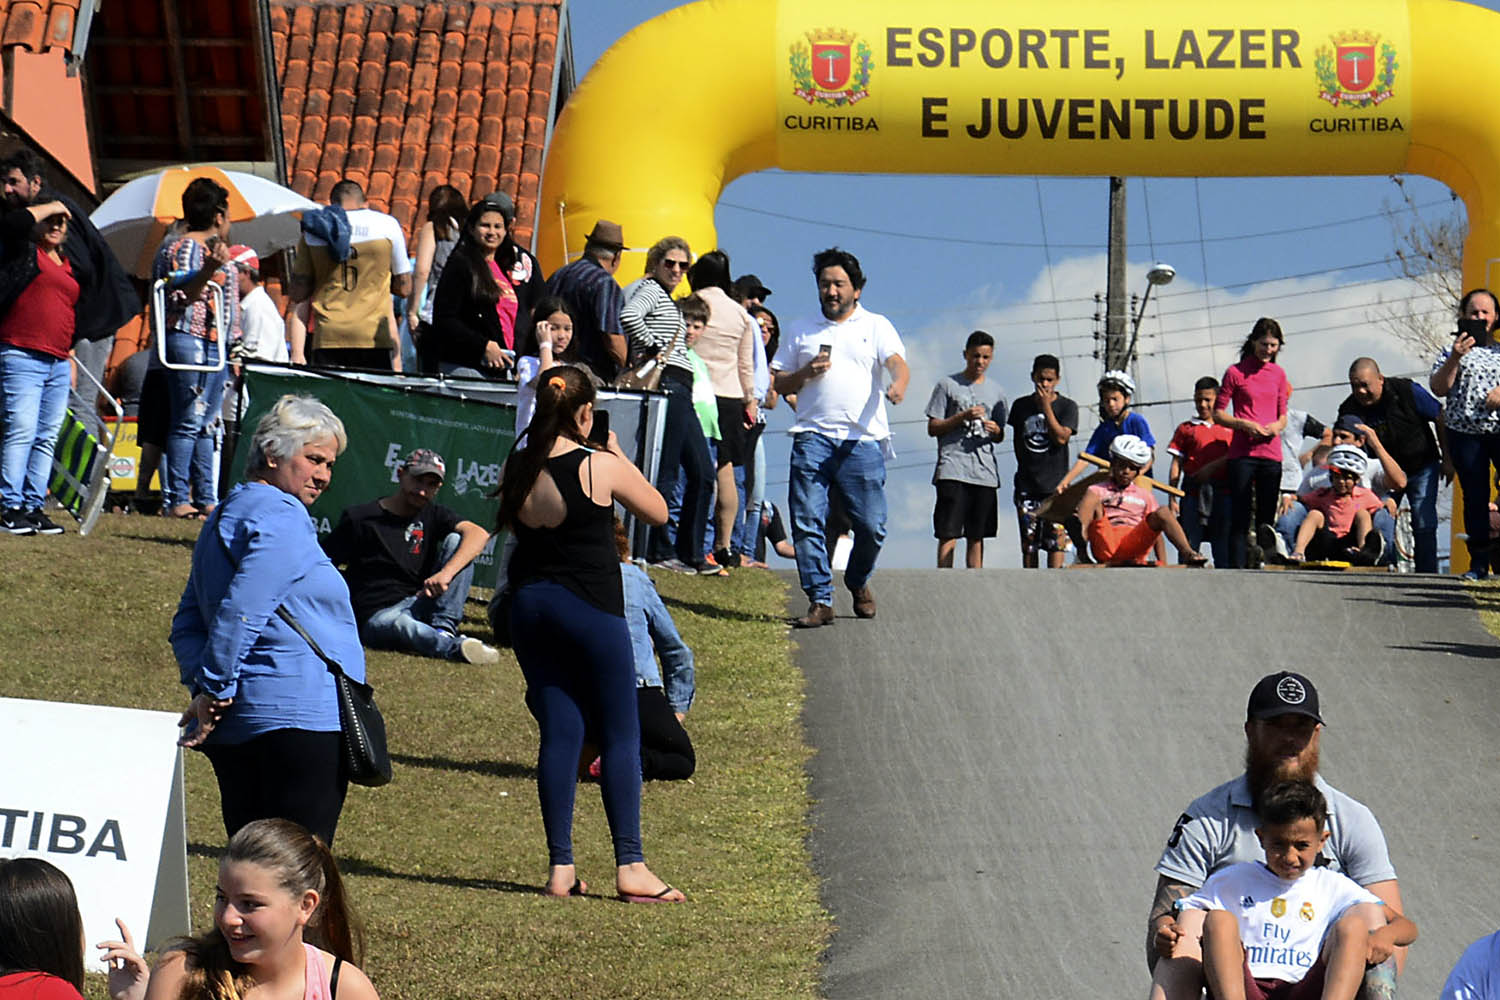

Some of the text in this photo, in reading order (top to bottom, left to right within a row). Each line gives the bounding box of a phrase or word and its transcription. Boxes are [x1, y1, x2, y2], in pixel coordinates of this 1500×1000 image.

[886, 27, 1302, 80] ESPORTE, LAZER
[784, 114, 880, 132] CURITIBA
[921, 97, 1267, 140] E JUVENTUDE
[1309, 116, 1404, 133] CURITIBA
[457, 458, 501, 487] LAZE
[1263, 922, 1291, 944] Fly
[1246, 942, 1313, 968] mirates
